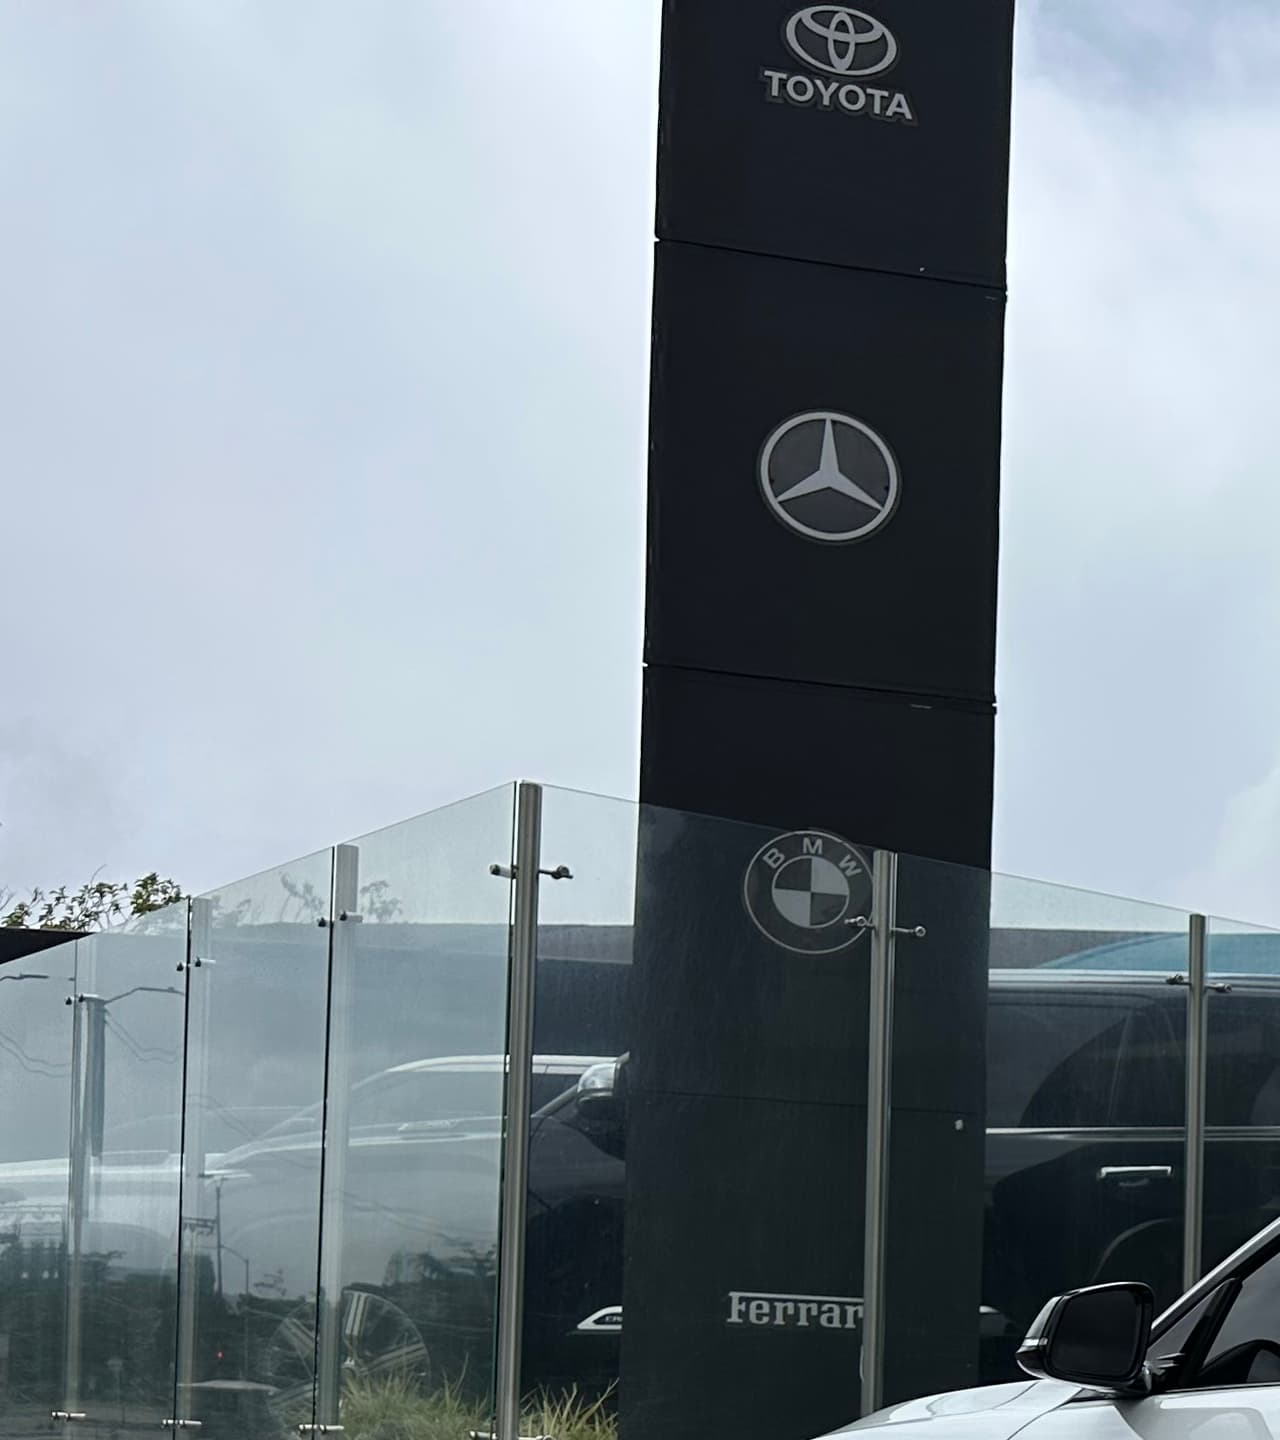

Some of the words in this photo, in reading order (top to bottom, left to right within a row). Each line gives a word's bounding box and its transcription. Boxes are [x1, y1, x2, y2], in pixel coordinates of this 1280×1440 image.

[764, 70, 913, 120] TOYOTA
[762, 837, 862, 877] BMW
[726, 1291, 864, 1329] Ferrar
